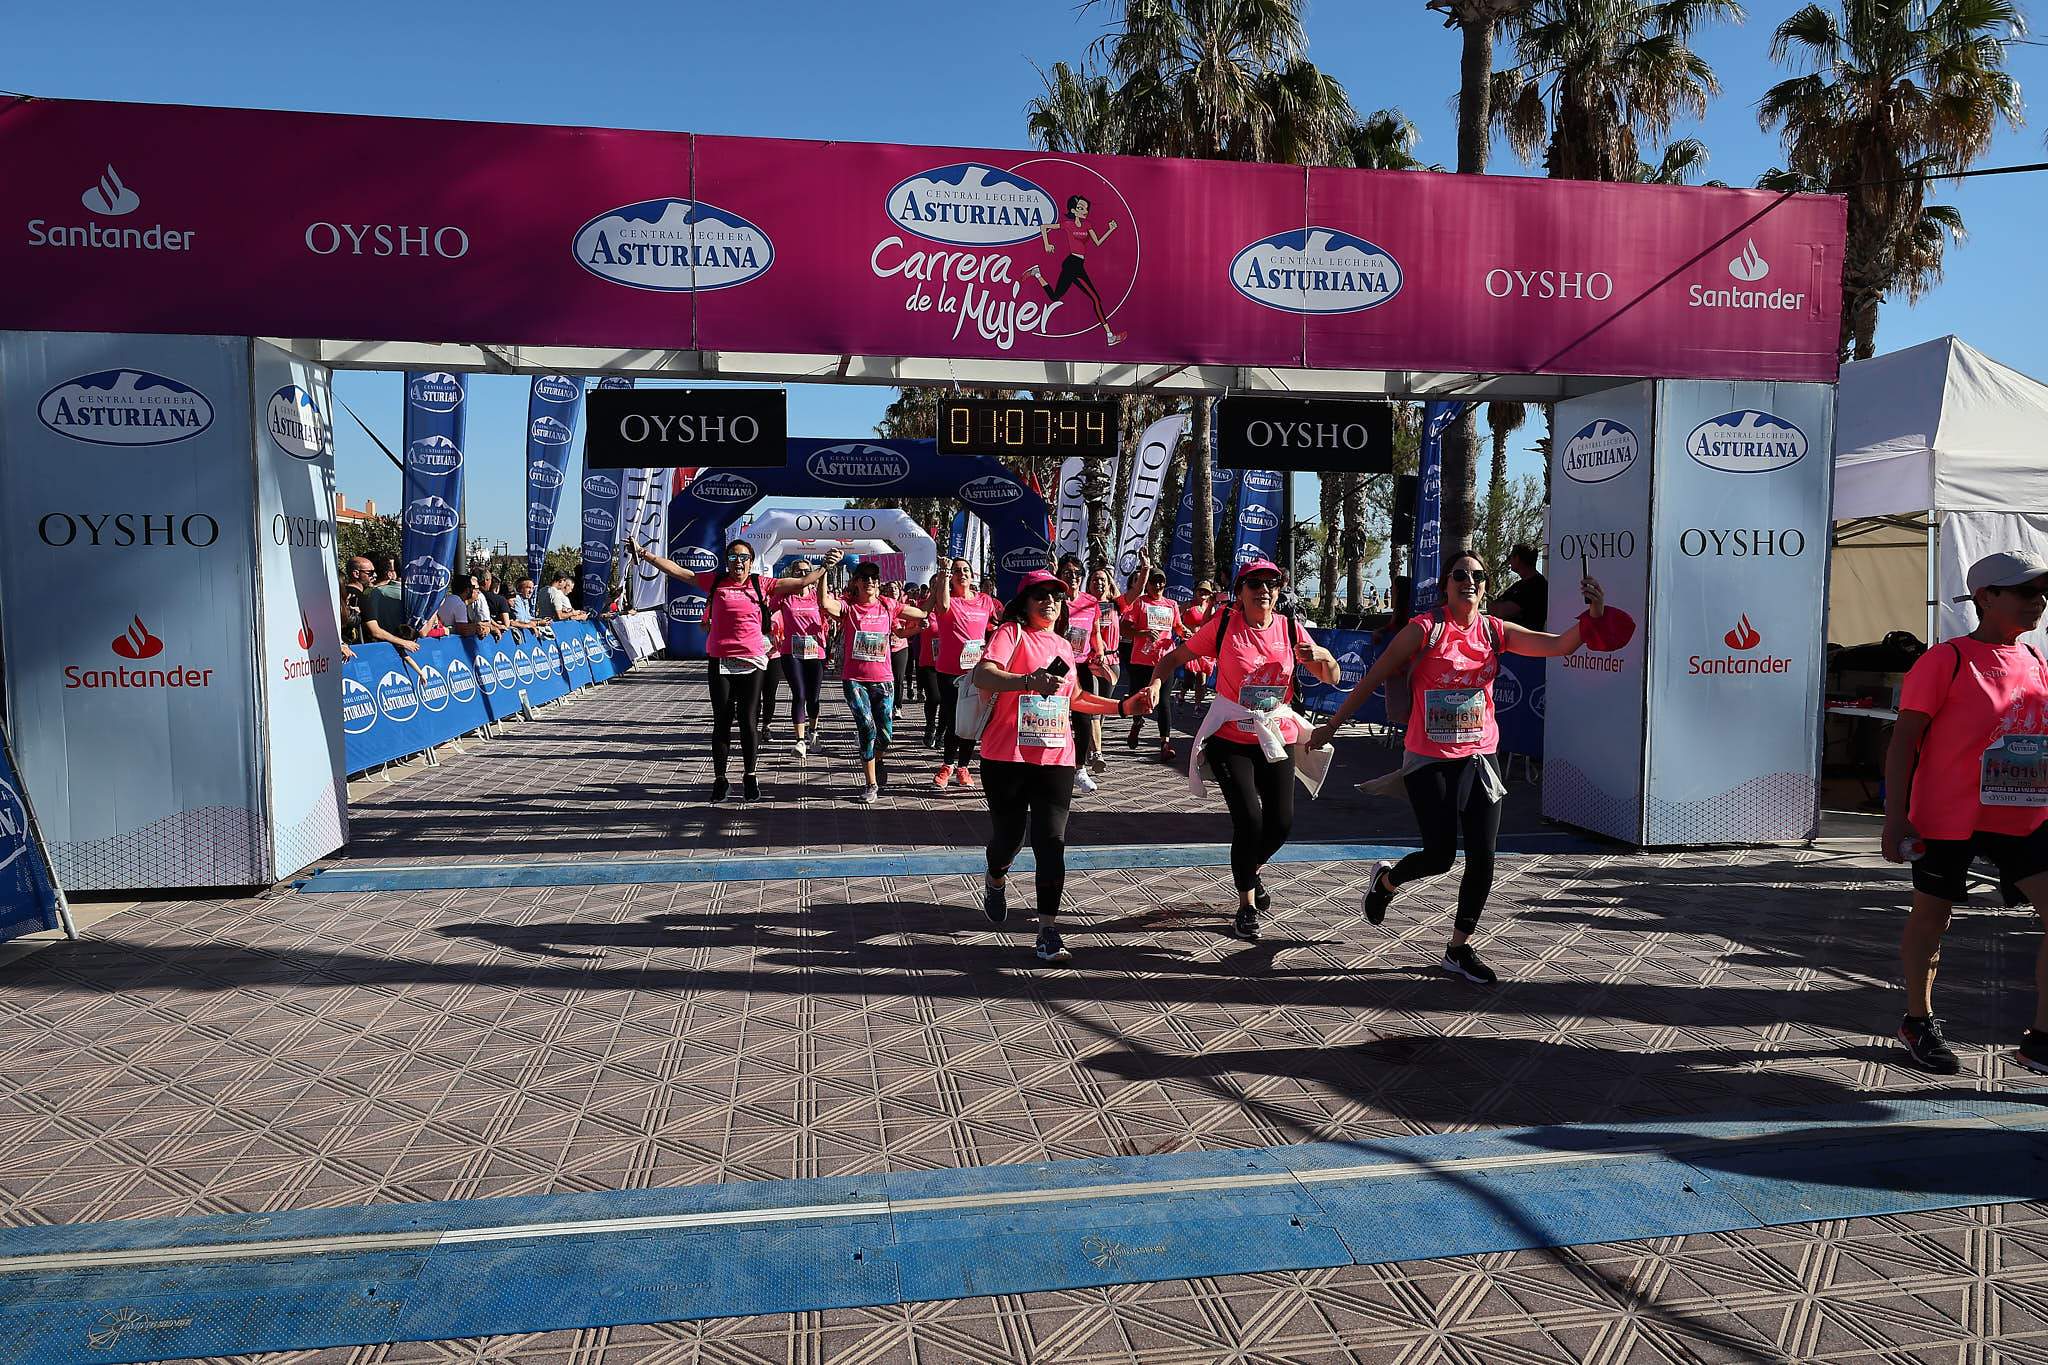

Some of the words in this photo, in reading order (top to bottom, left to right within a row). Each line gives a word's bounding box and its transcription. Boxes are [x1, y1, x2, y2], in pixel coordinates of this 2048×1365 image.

[900, 190, 1044, 227] ASTURIANA
[927, 189, 980, 201] CENTRAL
[986, 192, 1039, 203] LECHERA
[28, 219, 195, 251] Santander
[304, 222, 469, 258] OYSHO
[620, 229, 683, 240] CENTRAL
[589, 230, 759, 268] ASTURIANA
[871, 236, 1012, 284] Carrera
[1271, 256, 1323, 266] CENTRAL
[1329, 257, 1384, 268] LECHERA
[1243, 257, 1389, 293] ASTURIANA
[1485, 269, 1613, 301] OYSHO
[906, 283, 932, 312] de
[938, 283, 957, 313] la
[1689, 285, 1805, 310] Santander
[952, 281, 1064, 350] Mujer
[52, 397, 202, 427] ASTURIANA
[79, 395, 134, 404] CENTRAL
[140, 396, 195, 405] LECHERA
[272, 405, 323, 444] ASTURIANA
[620, 414, 760, 443] OYSHO
[951, 408, 1105, 445] 01:07:44
[1246, 420, 1369, 450] OYSHO
[1714, 431, 1752, 440] CENTRAL
[1755, 432, 1795, 440] LECHERA
[1566, 445, 1632, 471] ASTURIANA
[1695, 433, 1798, 458] ASTURIANA
[815, 456, 902, 476] ASTURIANA
[696, 484, 752, 497] ASTURIANA
[965, 487, 1019, 499] ASTURIANA
[1118, 441, 1167, 577] OYSHO
[38, 513, 219, 547] OYSHO
[272, 513, 330, 549] OYSHO
[795, 515, 876, 532] OYSHO
[1560, 530, 1635, 560] OYSHO
[1680, 529, 1806, 557] OYSHO
[676, 558, 715, 567] STURIANA
[1004, 558, 1047, 568] ASTURIAN
[670, 604, 704, 616] ASTURIA
[283, 654, 329, 680] Santander
[1563, 651, 1624, 672] Santander
[1689, 655, 1792, 675] Santander
[64, 665, 213, 689] Santander
[343, 701, 376, 722] STURIANA
[382, 692, 417, 712] ASTURIANA
